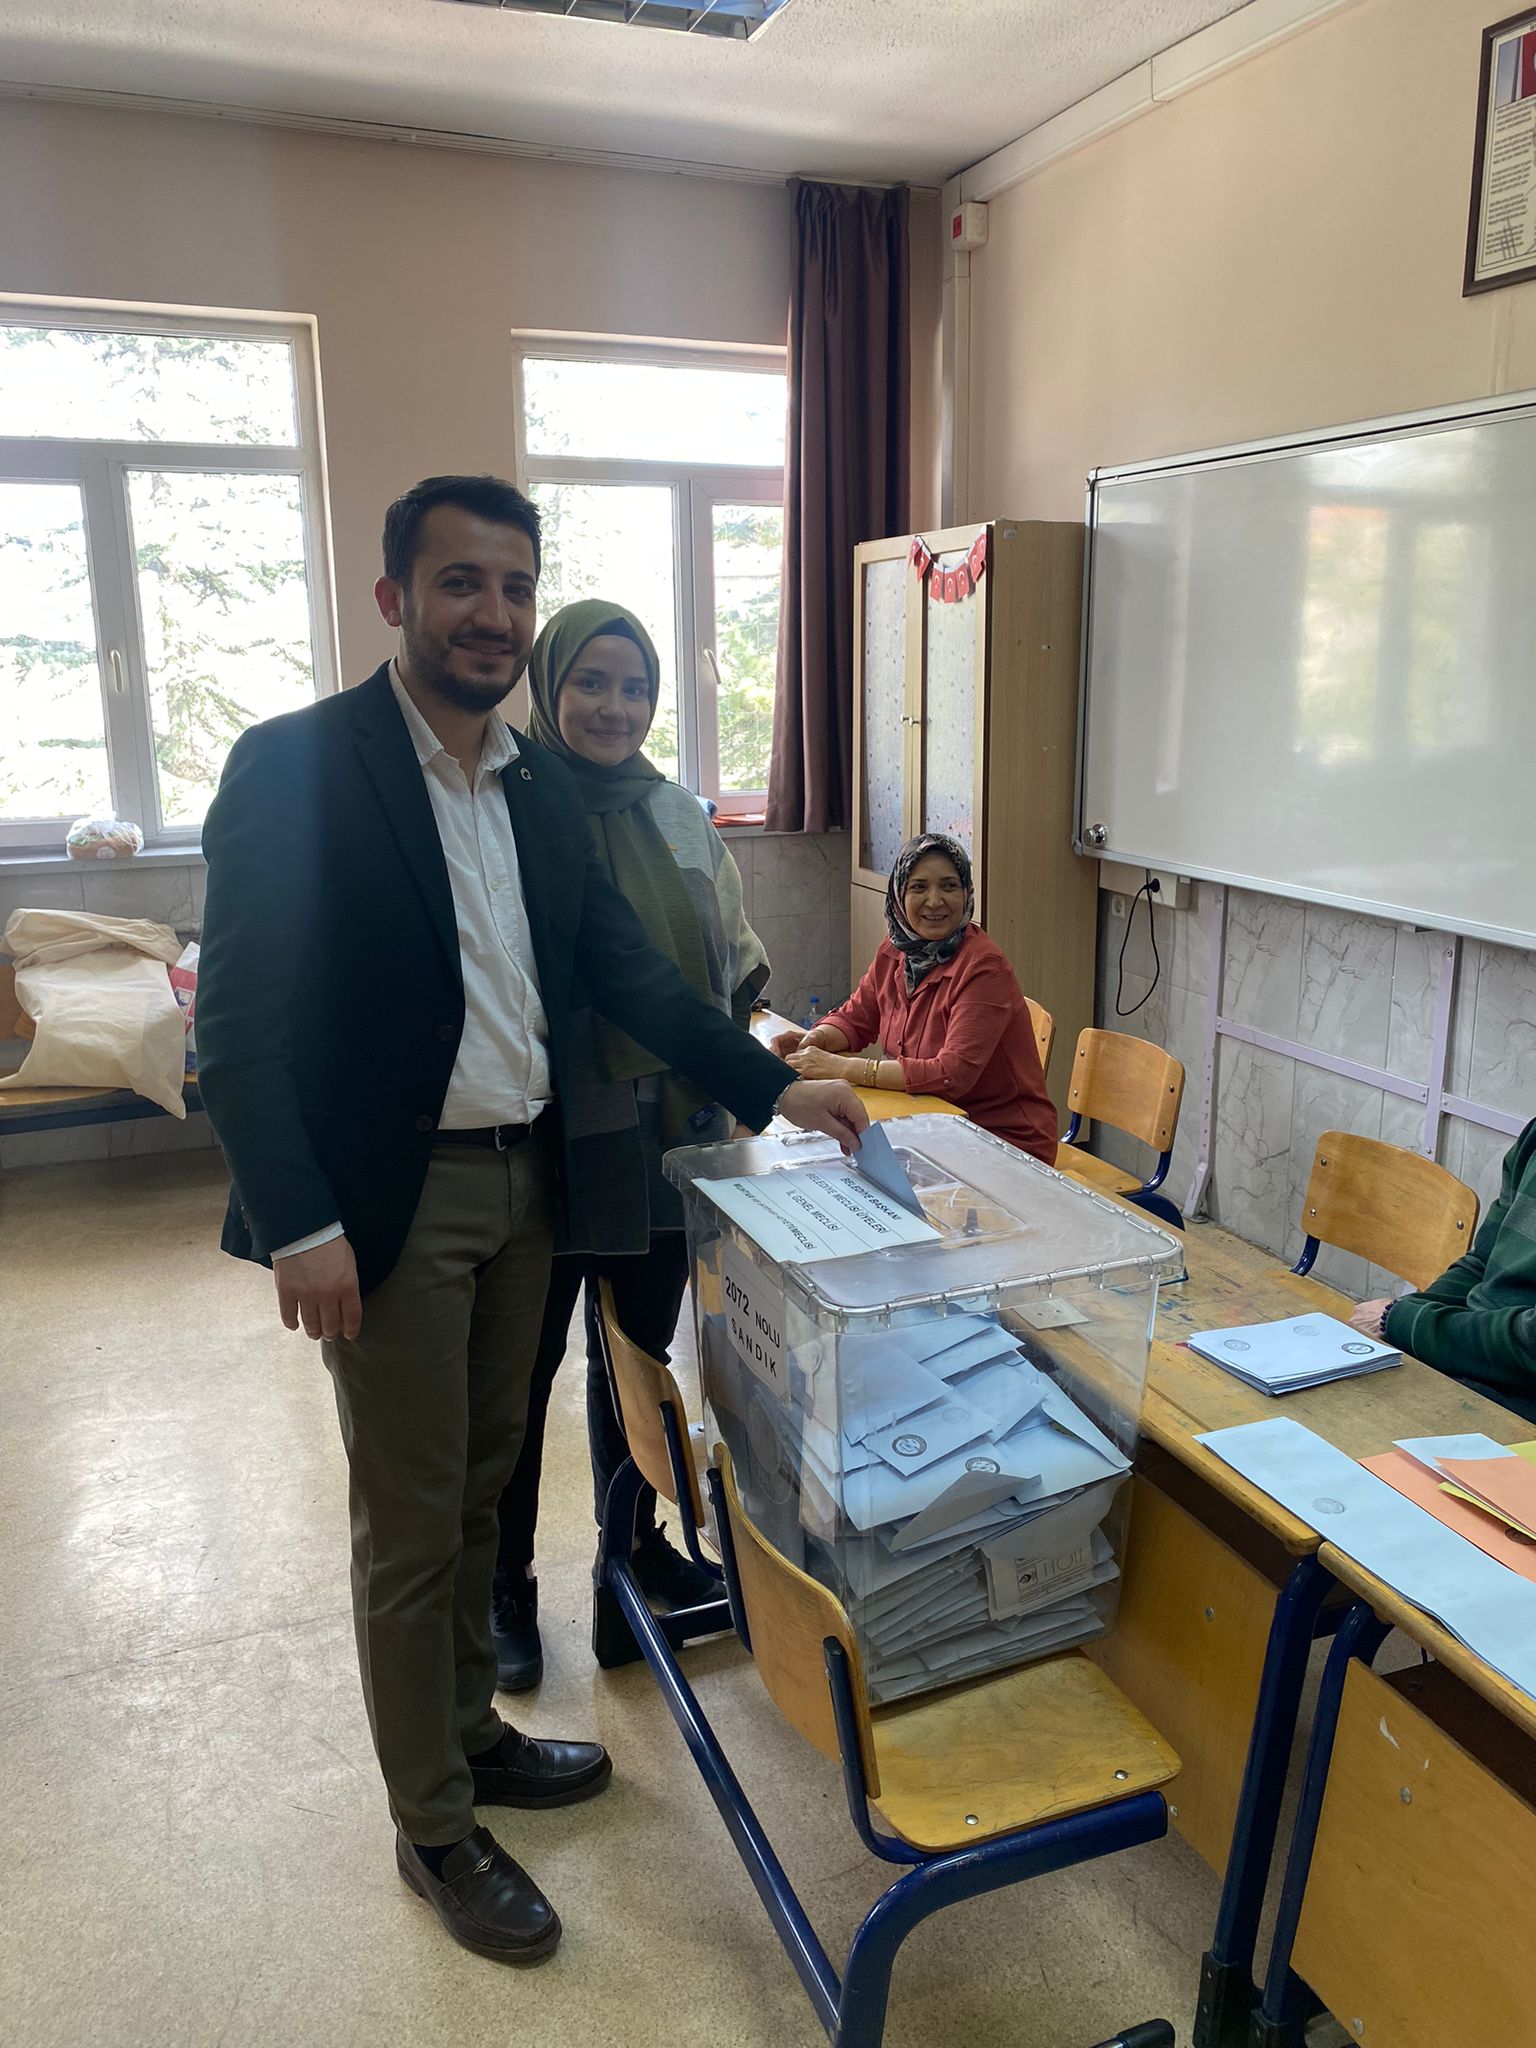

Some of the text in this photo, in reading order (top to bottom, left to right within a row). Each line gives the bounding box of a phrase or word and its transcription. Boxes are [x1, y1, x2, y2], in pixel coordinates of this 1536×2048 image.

[792, 1195, 815, 1212] GENEL
[810, 1210, 843, 1231] MECLİSİ
[806, 1173, 838, 1194] BELEDİYE
[832, 1193, 863, 1213] MECLİSİ
[840, 1177, 903, 1220] BELEDİYE BAŞKANI
[725, 1275, 780, 1349] 2072 NOLU
[731, 1318, 778, 1378] SANDIK
